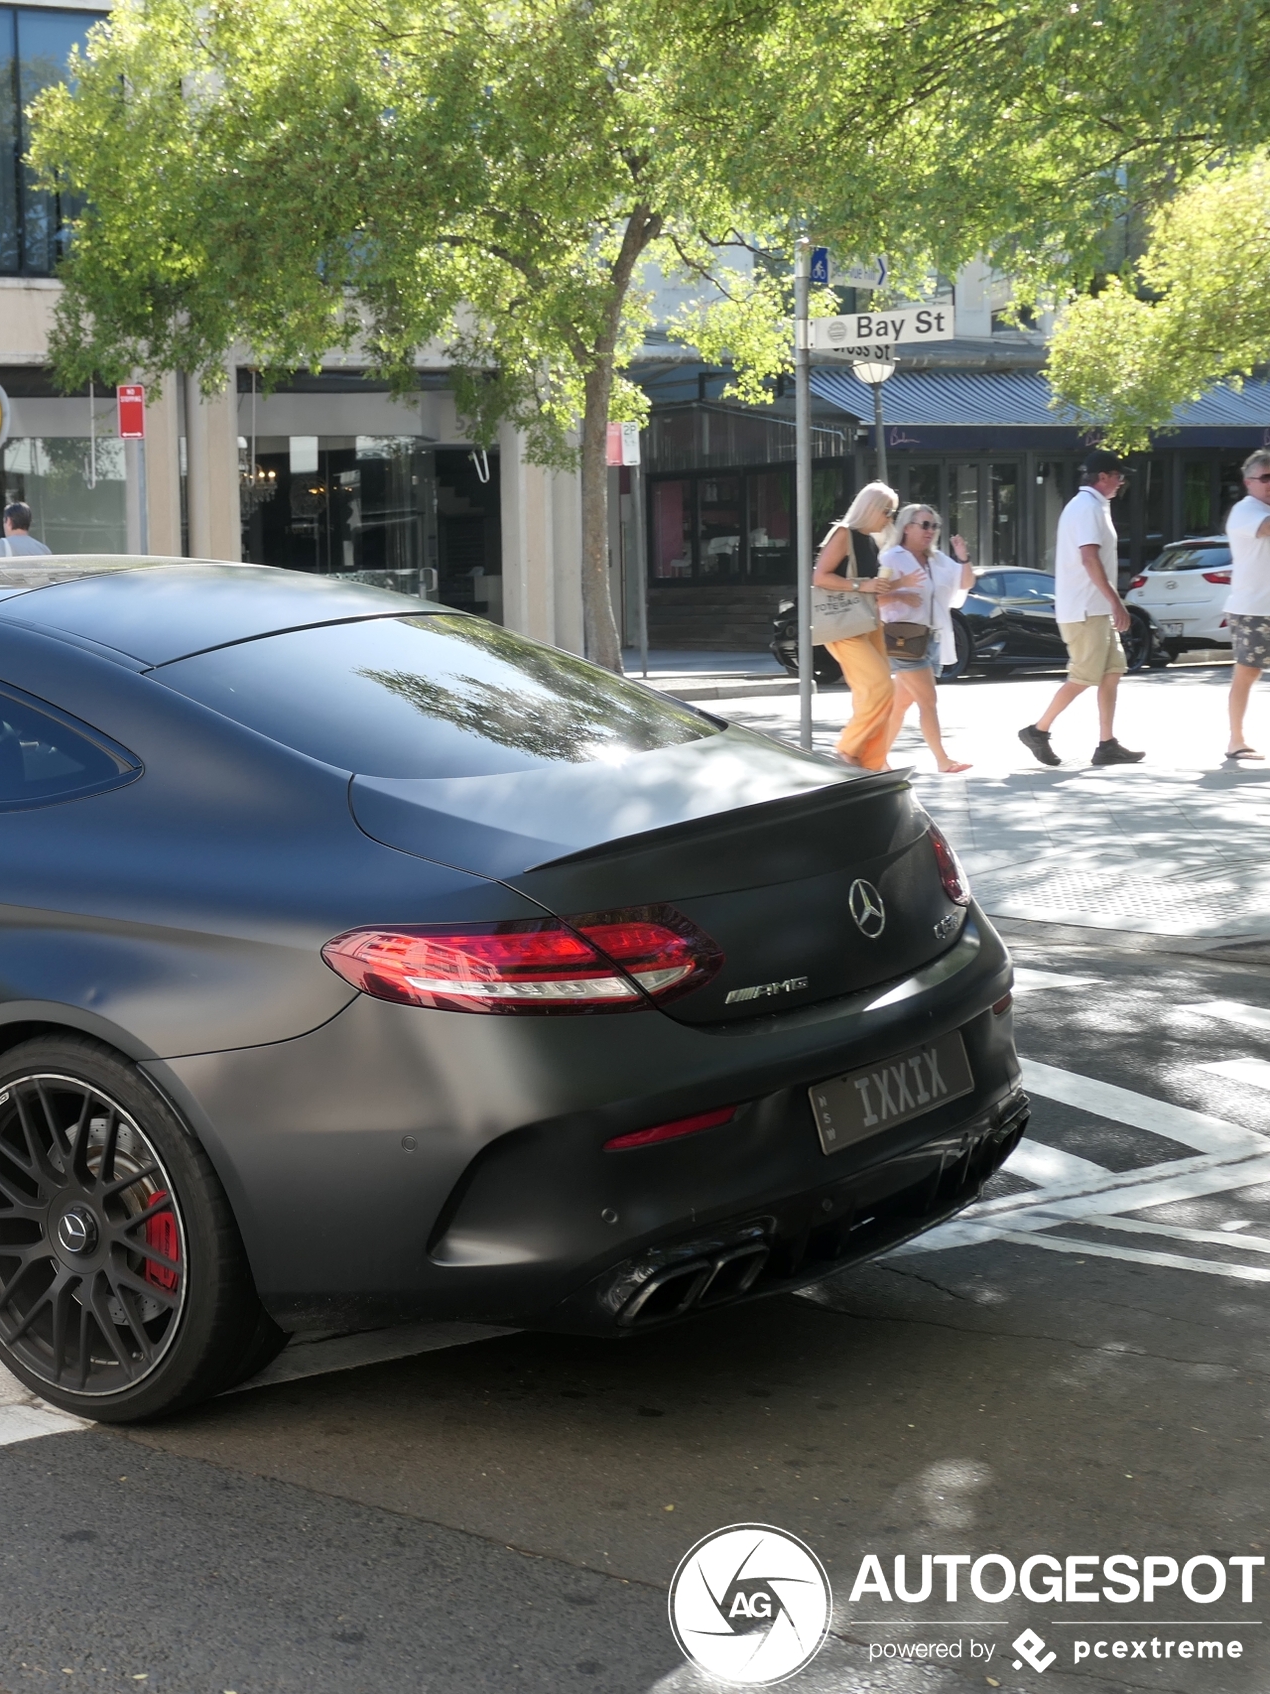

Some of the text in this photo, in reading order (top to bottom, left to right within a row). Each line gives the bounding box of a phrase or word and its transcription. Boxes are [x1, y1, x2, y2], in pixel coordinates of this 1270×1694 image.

[856, 310, 946, 341] Bay St
[832, 344, 891, 361] oss St
[854, 1048, 948, 1127] IXXIX
